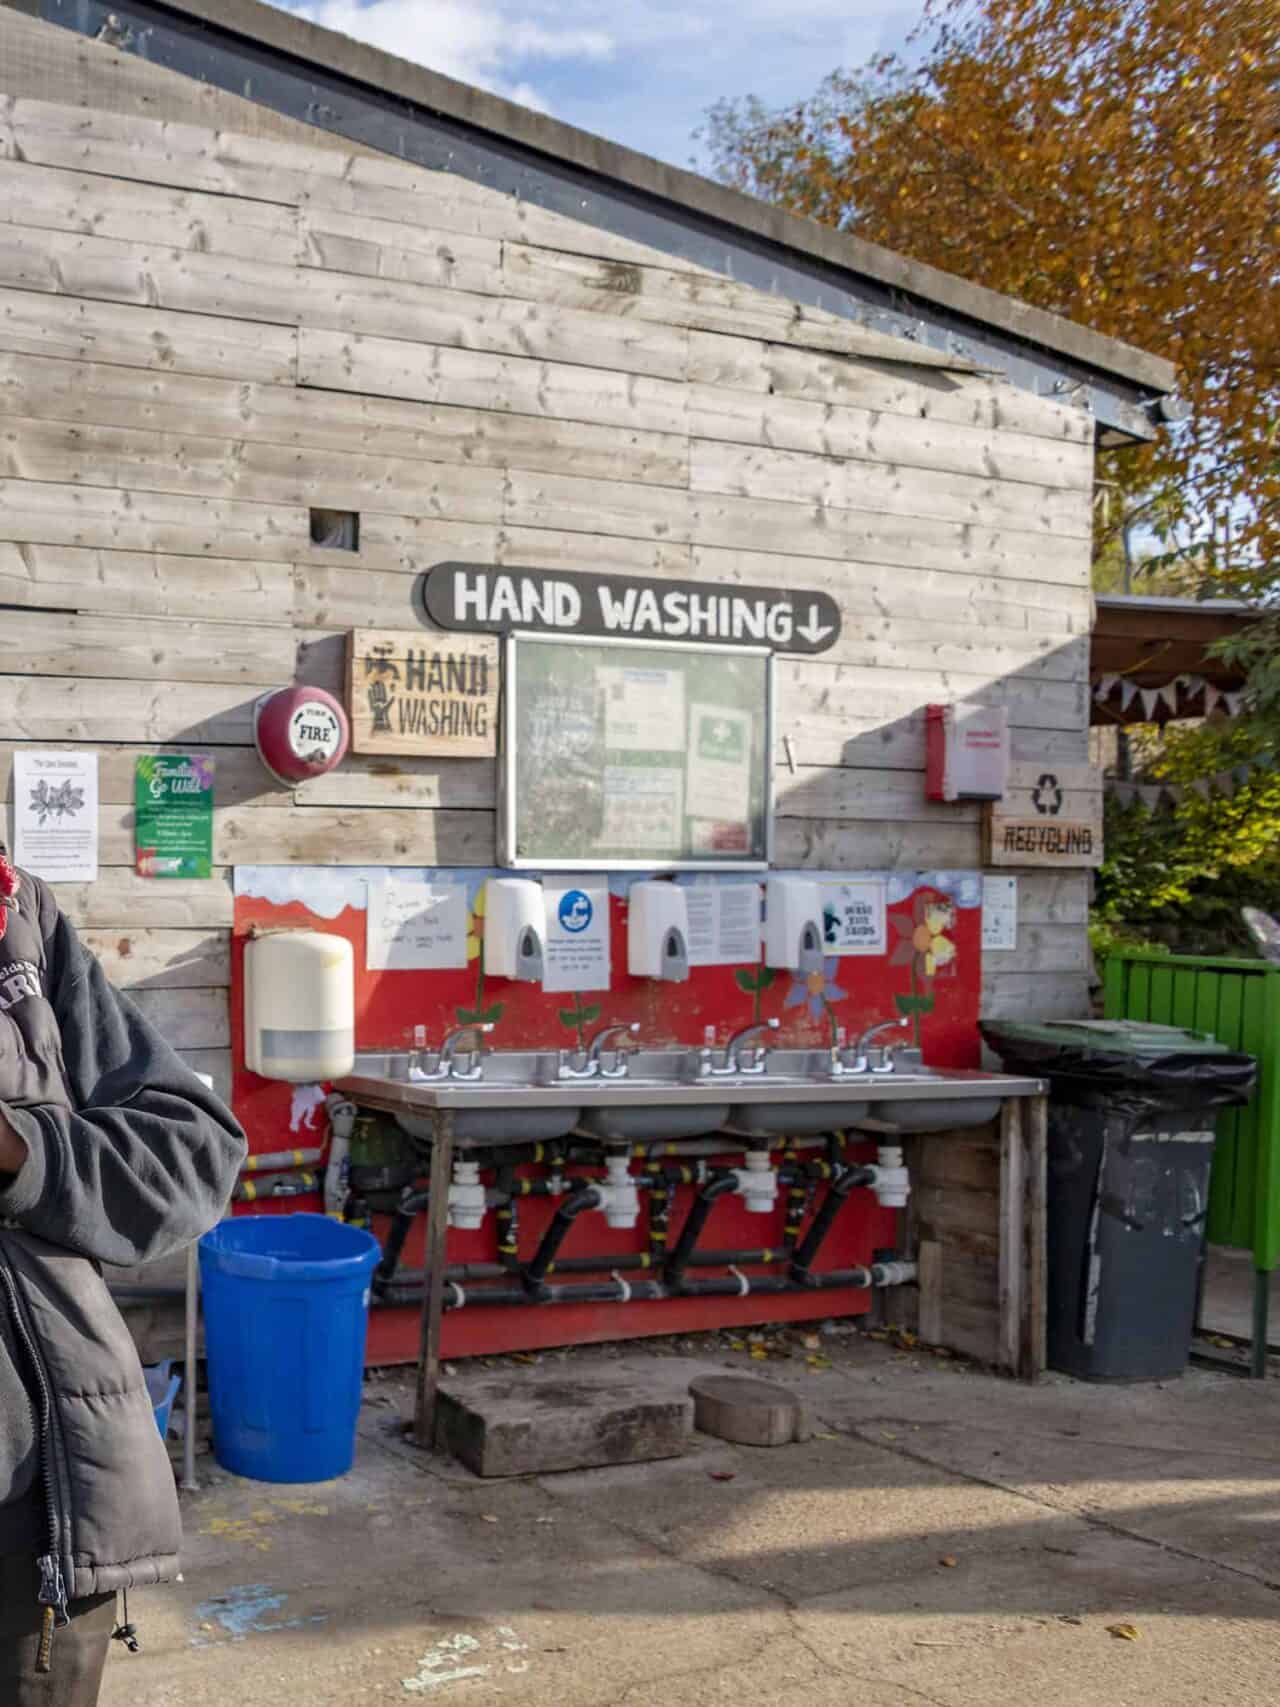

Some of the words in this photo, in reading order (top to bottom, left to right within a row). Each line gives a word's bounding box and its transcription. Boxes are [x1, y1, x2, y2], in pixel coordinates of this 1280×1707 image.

[454, 572, 581, 626] HAND
[598, 585, 792, 642] WASHING
[406, 649, 488, 696] HAND
[300, 725, 330, 742] FIRE
[399, 700, 487, 736] WASHING
[150, 778, 167, 799] Go
[172, 777, 202, 794] Wild
[1004, 826, 1092, 854] RECYCLING
